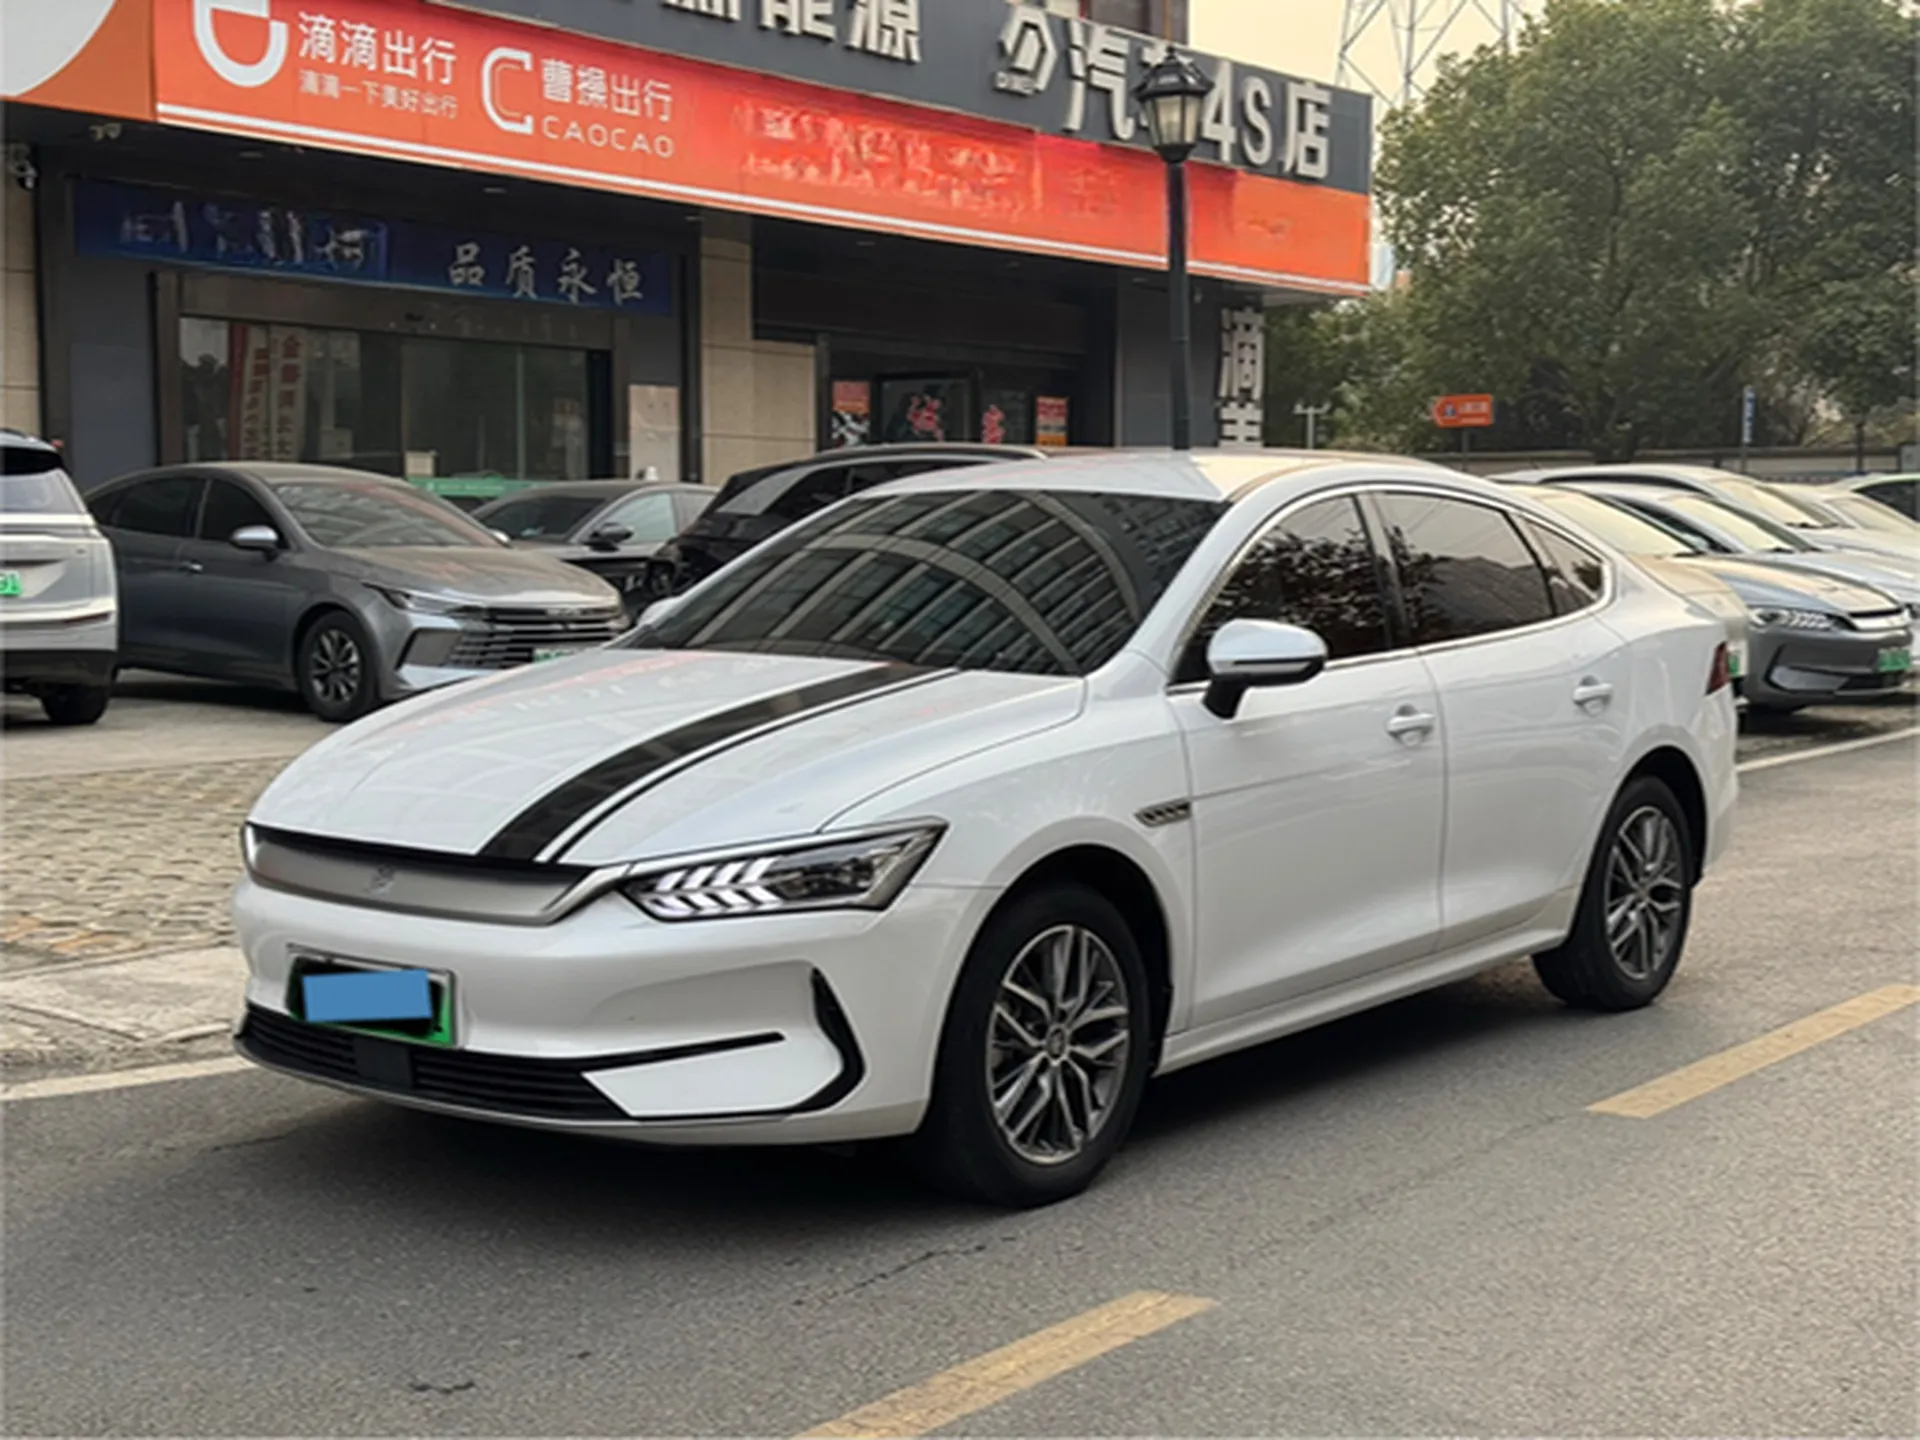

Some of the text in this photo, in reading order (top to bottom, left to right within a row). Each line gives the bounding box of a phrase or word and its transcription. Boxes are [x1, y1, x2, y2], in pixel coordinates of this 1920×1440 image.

[299, 11, 457, 85] 滴滴出行
[541, 58, 672, 122] 曹操出行
[1062, 19, 1332, 180] 汽4S店
[541, 115, 675, 159] CAOCAO
[449, 241, 644, 306] 品质永恒
